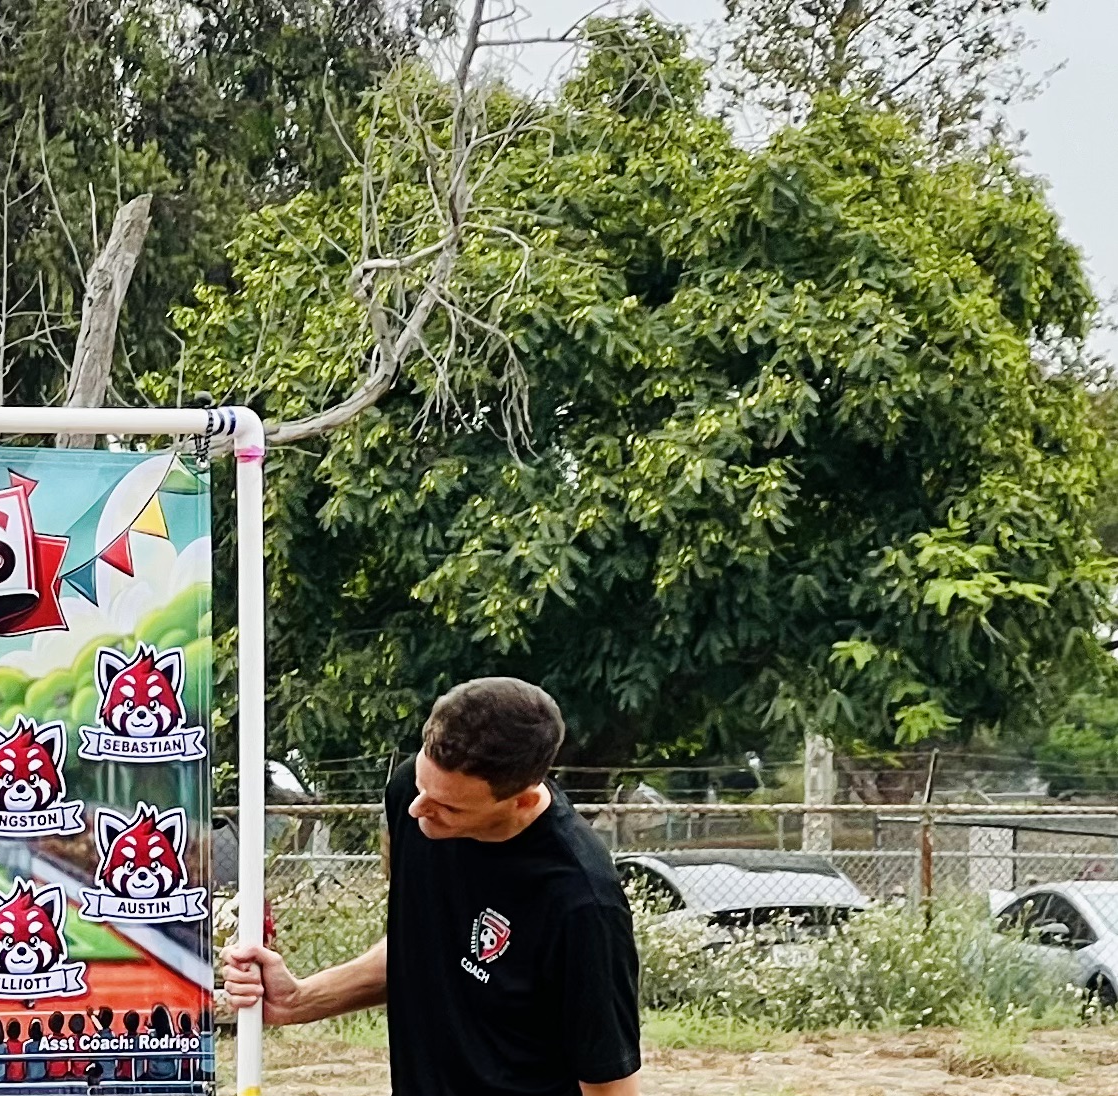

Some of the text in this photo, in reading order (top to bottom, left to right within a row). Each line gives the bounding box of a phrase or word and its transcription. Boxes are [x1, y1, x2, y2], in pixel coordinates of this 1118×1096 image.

[102, 736, 184, 755] SEBASTIAN
[117, 900, 172, 915] AUSTIN
[460, 956, 491, 984] COACH
[38, 1033, 200, 1053] Asst Coach: Rodrigo
